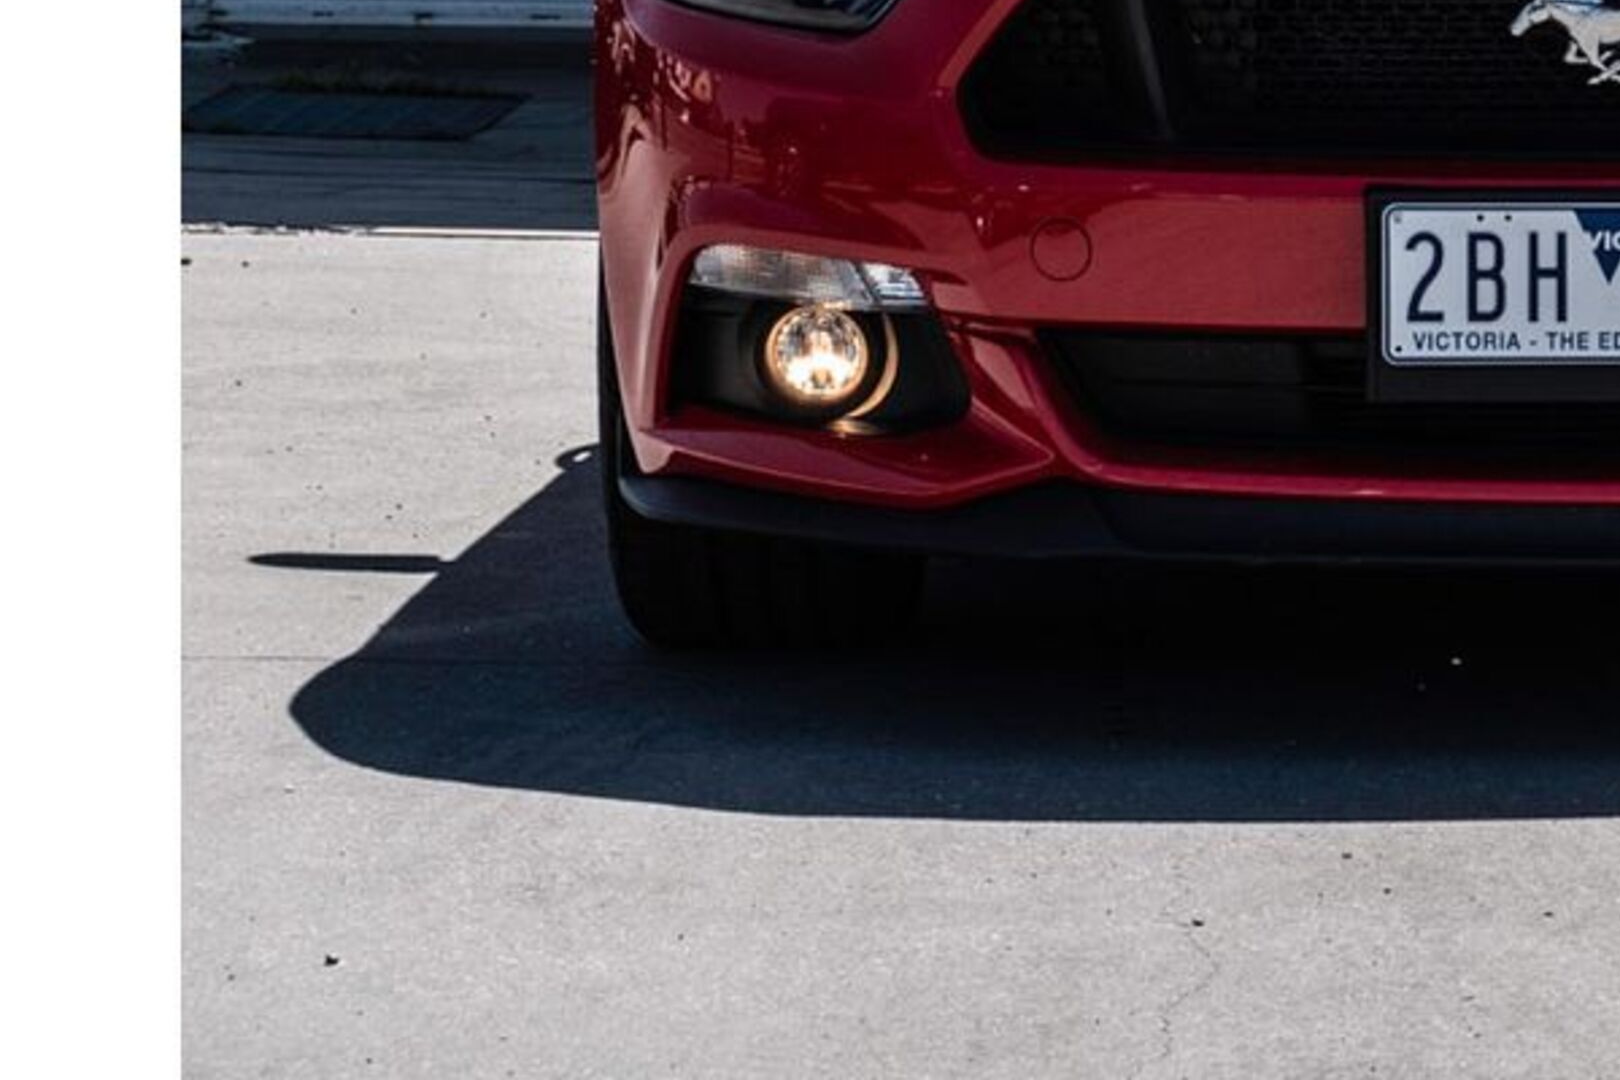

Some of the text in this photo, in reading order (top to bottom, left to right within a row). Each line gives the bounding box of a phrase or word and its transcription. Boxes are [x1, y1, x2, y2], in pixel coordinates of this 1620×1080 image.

[1405, 230, 1568, 323] 2BH
[1412, 331, 1521, 351] VICTORIA
[1546, 331, 1590, 351] THE
